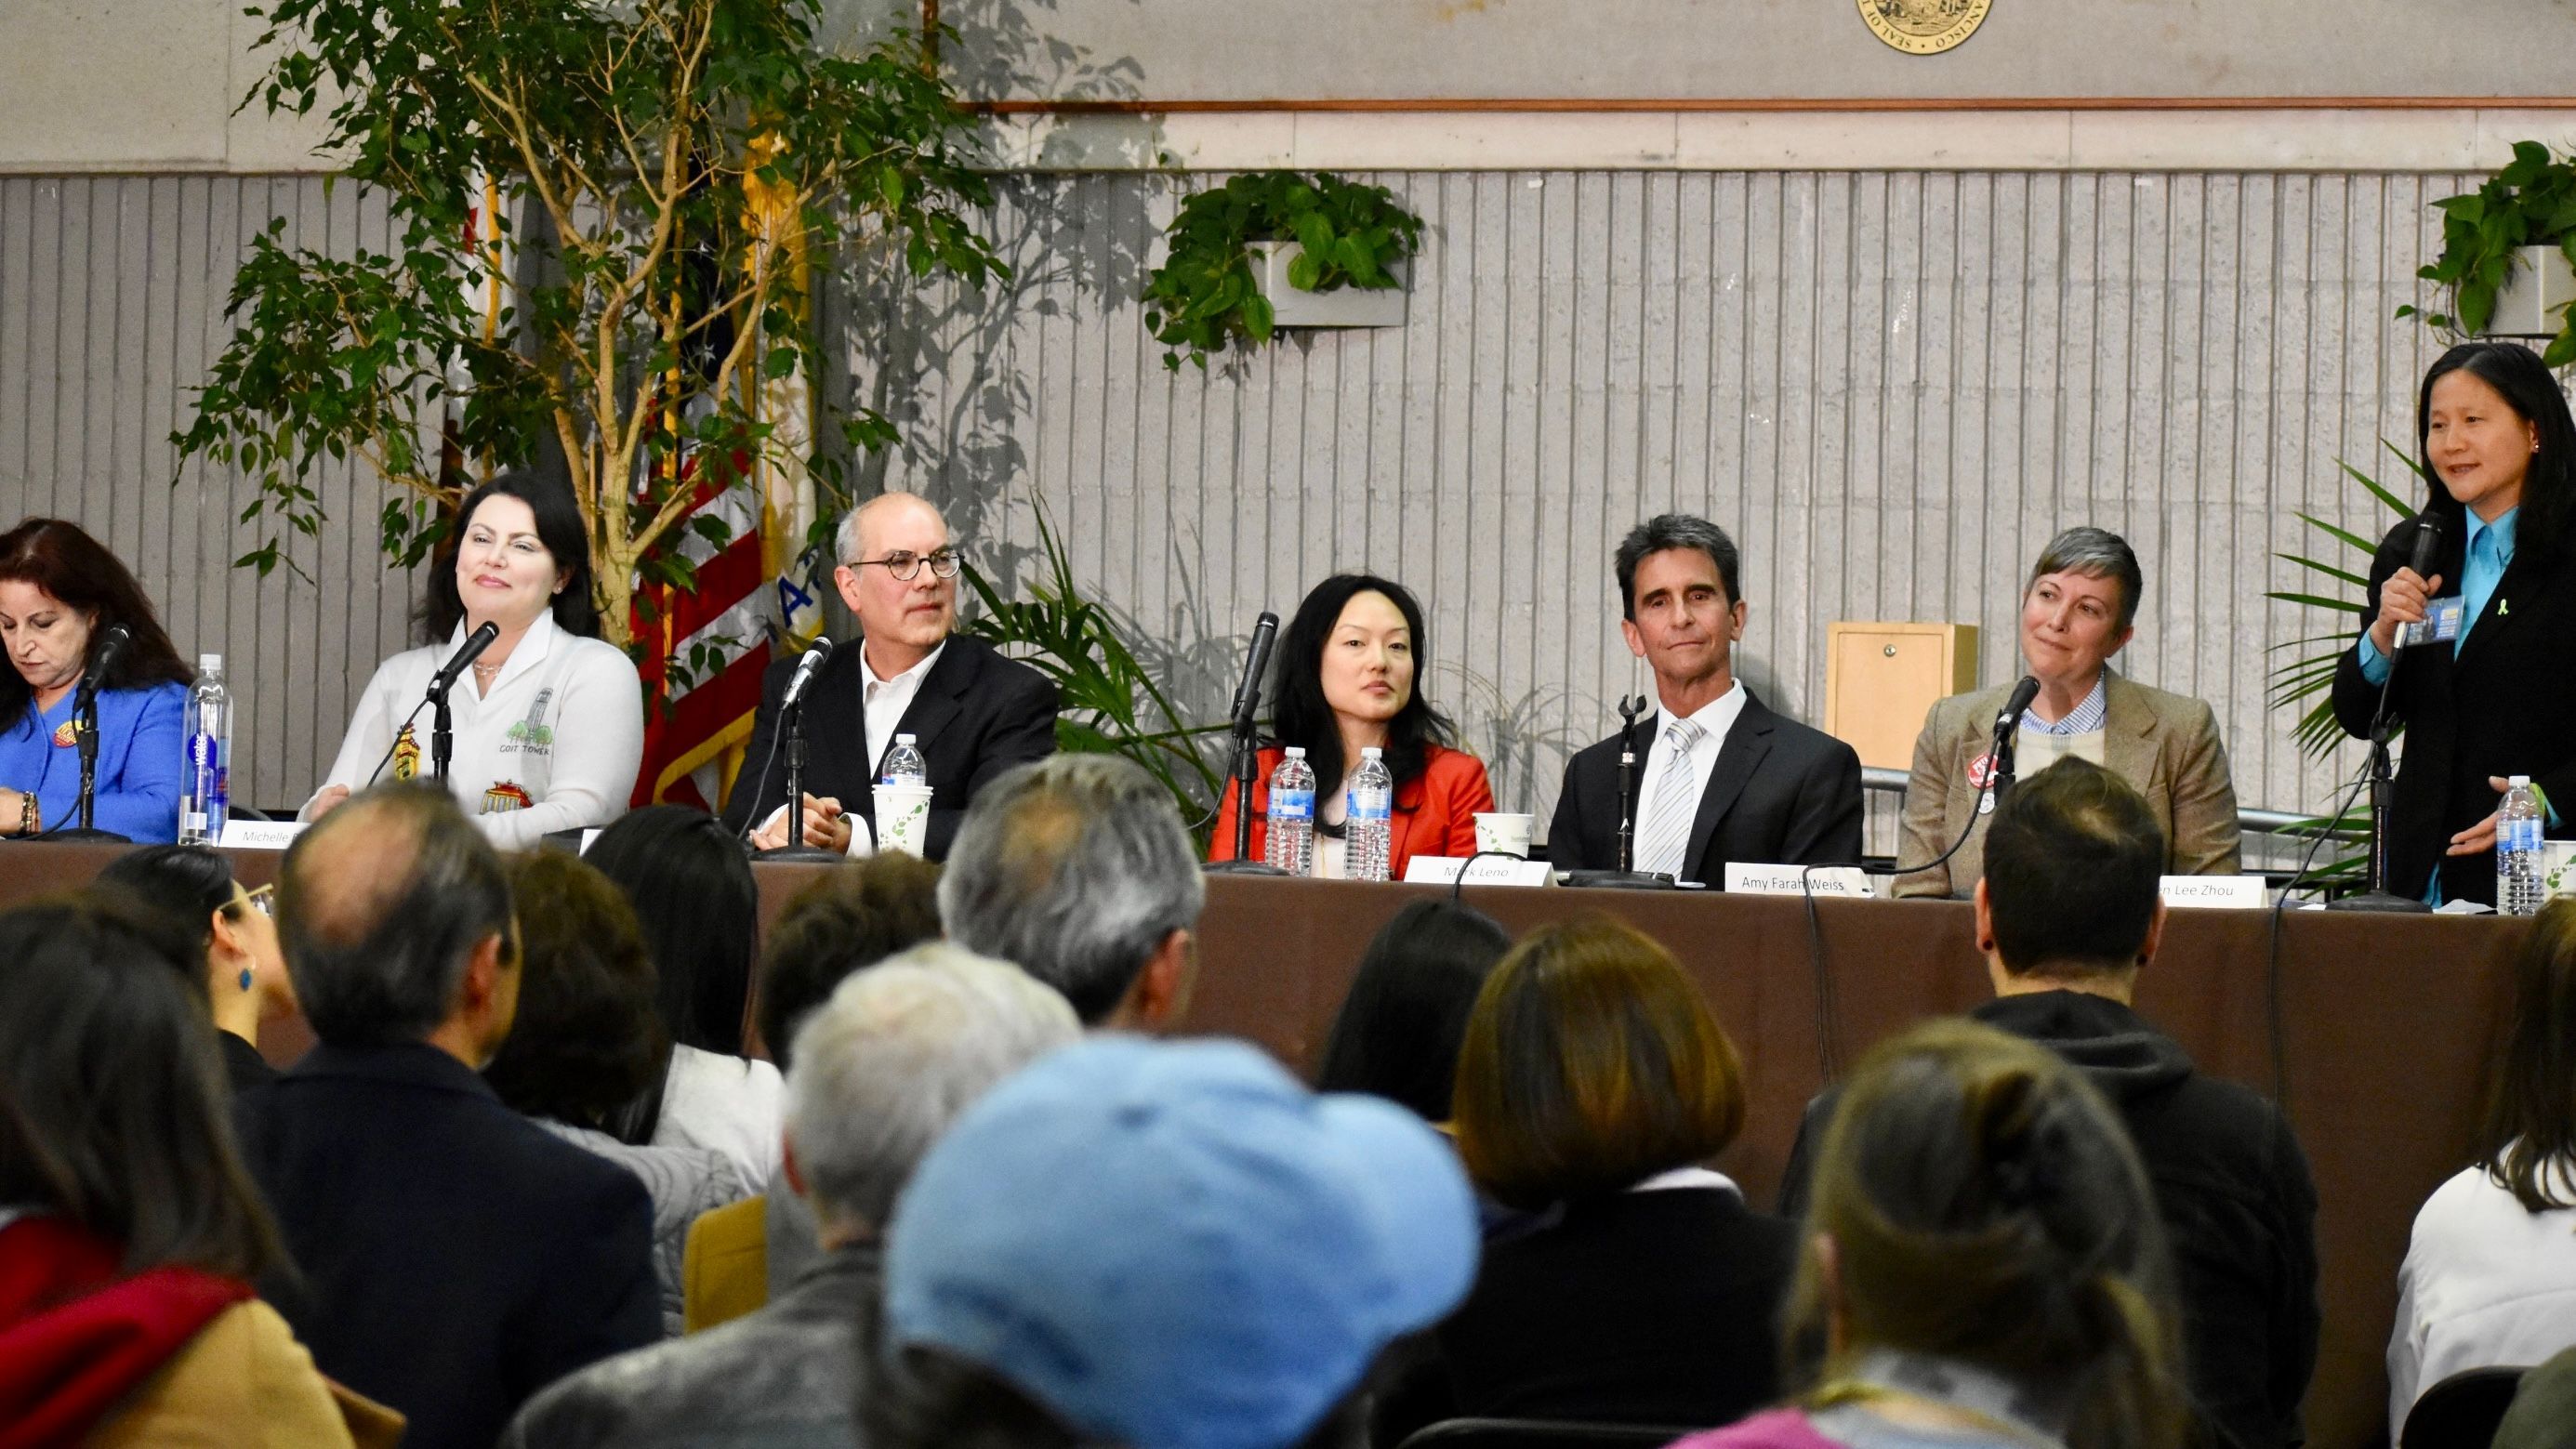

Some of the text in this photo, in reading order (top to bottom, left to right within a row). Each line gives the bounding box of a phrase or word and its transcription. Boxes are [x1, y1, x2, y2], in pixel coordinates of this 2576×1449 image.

[1867, 10, 1912, 48] SEAL OF
[1935, 1, 1983, 47] ANCISCO
[522, 744, 550, 756] TOWER
[243, 831, 289, 842] Michelle
[1444, 867, 1509, 877] Mrk Leno
[1742, 876, 1844, 891] Amy Farah Weiss
[2174, 884, 2198, 896] Lee
[2200, 885, 2234, 896] Zhou
